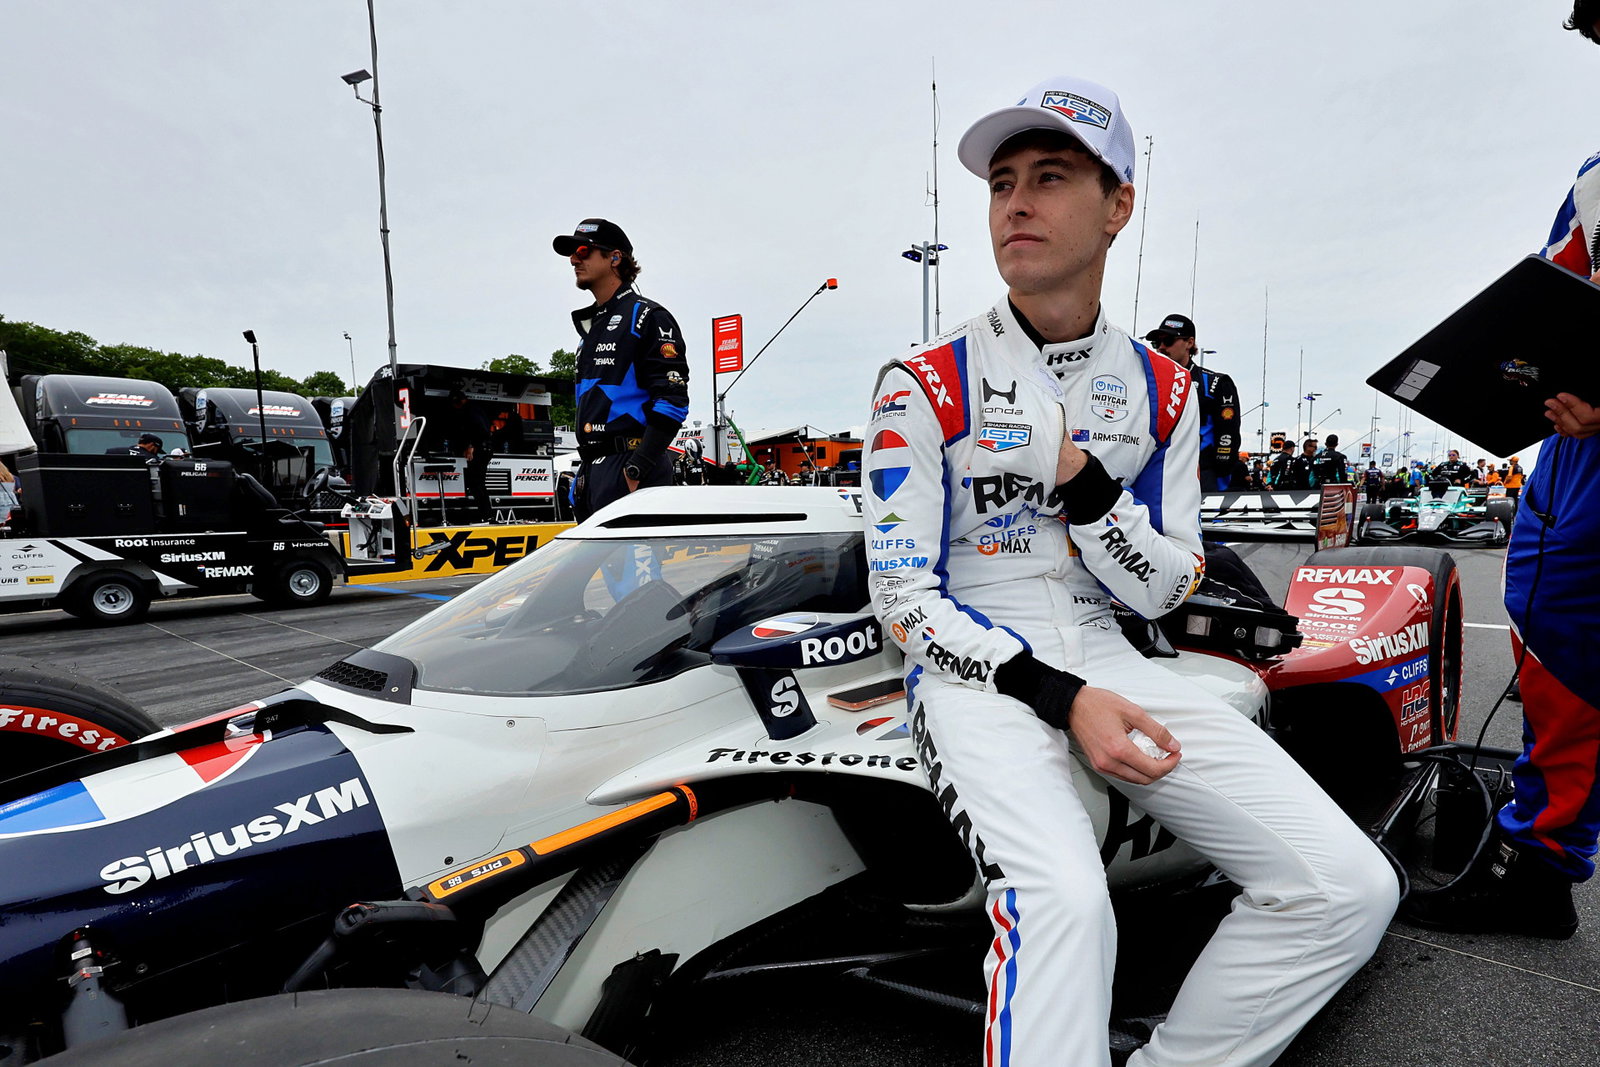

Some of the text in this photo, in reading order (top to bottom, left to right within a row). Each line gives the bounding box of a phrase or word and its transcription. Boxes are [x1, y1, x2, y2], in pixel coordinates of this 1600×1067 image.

[1045, 96, 1107, 125] MSR
[595, 342, 616, 353] Root
[1046, 347, 1093, 366] HRX
[911, 356, 954, 408] HRX
[1107, 383, 1124, 394] NTT
[1091, 393, 1128, 406] INDYCAR
[399, 388, 411, 429] 3
[592, 424, 606, 432] MAX
[195, 463, 207, 471] 66
[115, 538, 195, 548] Root Insurance
[979, 525, 1037, 546] CLIFFS
[273, 542, 285, 550] 66
[1001, 538, 1031, 554] MAX
[160, 551, 226, 563] SiriusXM
[870, 556, 928, 571] iriusXM
[205, 566, 255, 578] REMAX
[1296, 568, 1395, 586] REMAX
[1165, 574, 1189, 609] CURB
[900, 605, 929, 634] MAX
[1298, 618, 1358, 631] Root
[1304, 612, 1362, 622] SiriusXM
[801, 625, 878, 665] Root
[1349, 621, 1430, 665] SiriusXM
[1402, 658, 1428, 680] CLIFFS
[265, 714, 279, 724] 247
[0, 707, 117, 751] Firest
[706, 747, 919, 771] Firestone
[100, 777, 370, 895] SiriusXM
[448, 860, 503, 888] PITS 66
[1492, 862, 1506, 876] OMP
